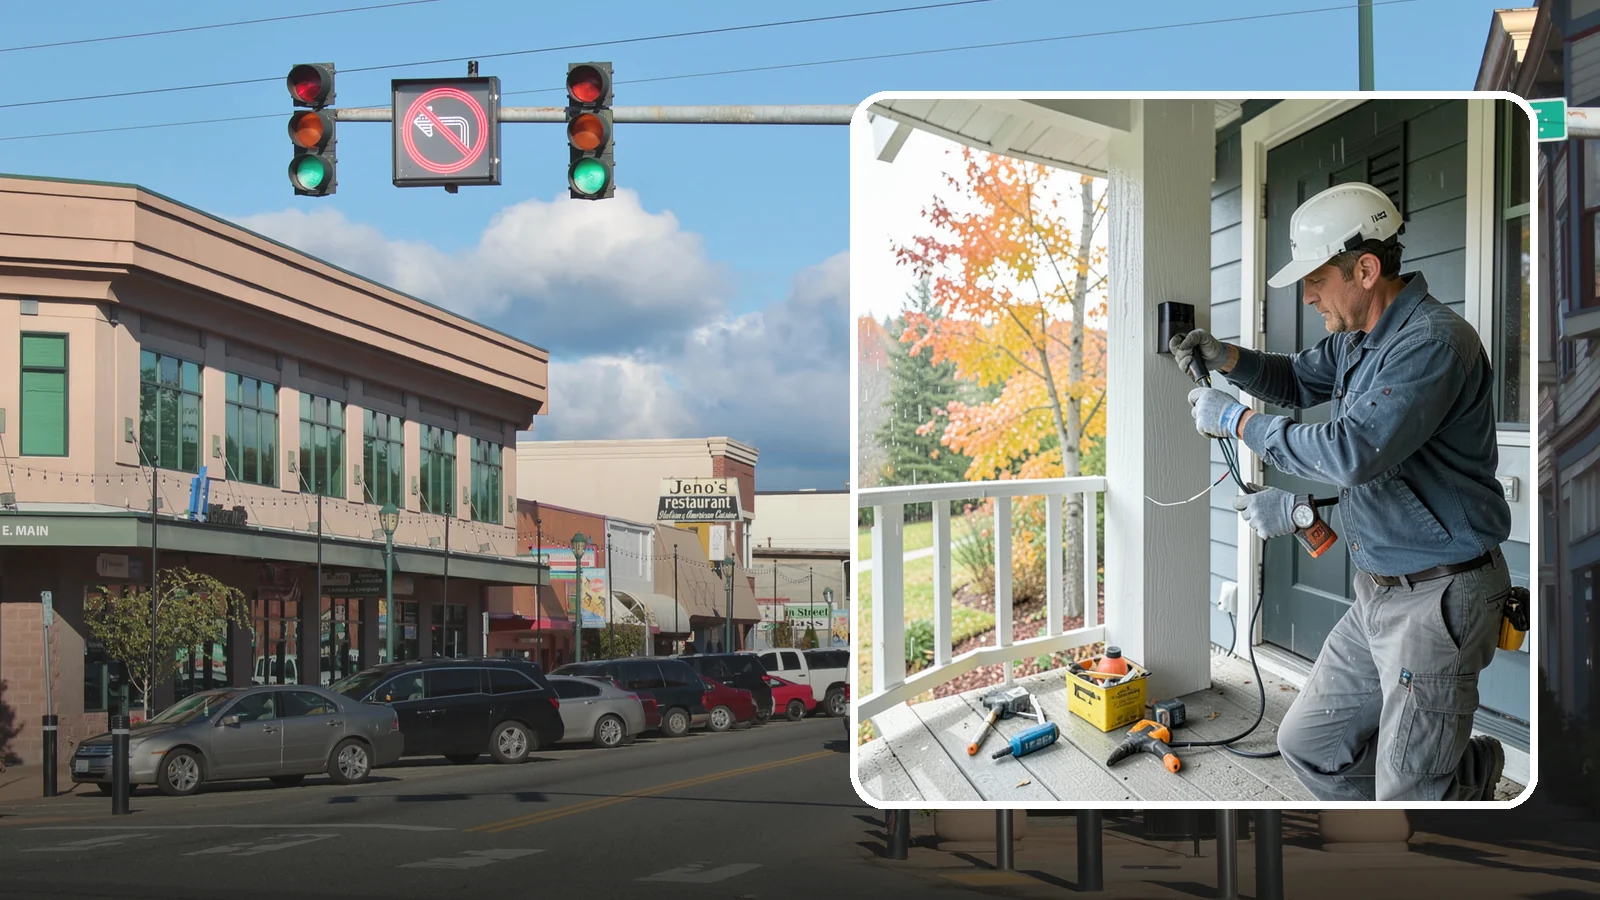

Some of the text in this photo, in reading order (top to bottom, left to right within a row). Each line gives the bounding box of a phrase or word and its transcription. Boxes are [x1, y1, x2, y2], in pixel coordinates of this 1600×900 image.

[670, 480, 728, 495] Jeno's
[665, 496, 731, 509] restaurant
[658, 510, 682, 520] Italian
[686, 510, 714, 519] American
[715, 510, 738, 519] Cuisine
[2, 525, 49, 536] E. MAIN
[797, 607, 829, 617] Street
